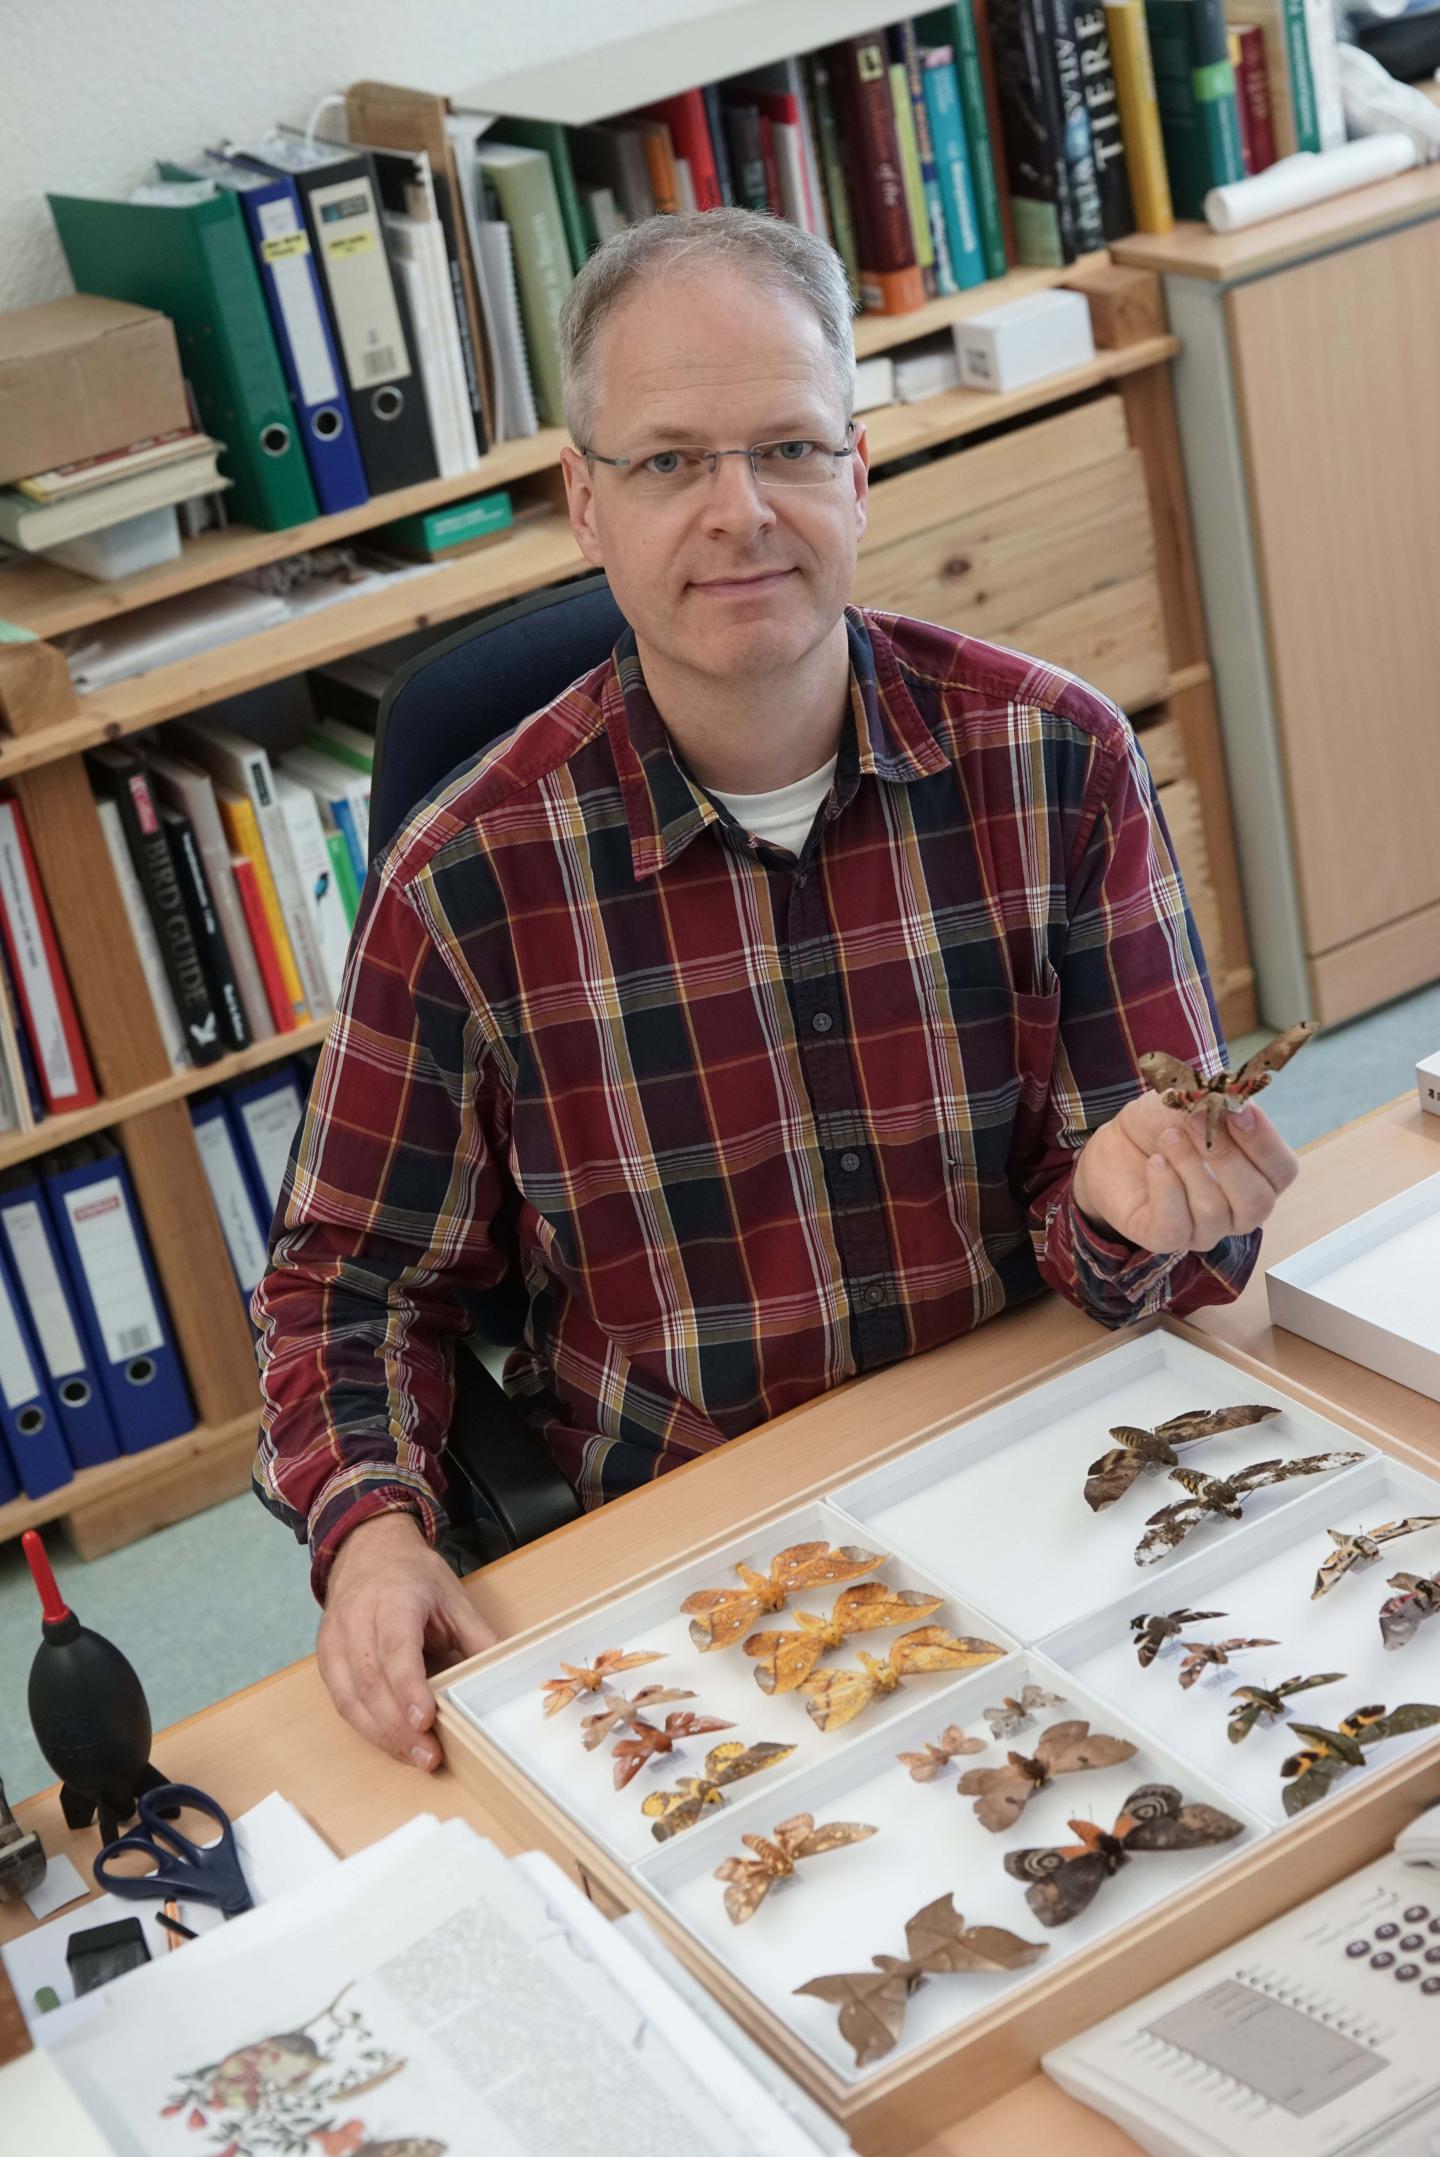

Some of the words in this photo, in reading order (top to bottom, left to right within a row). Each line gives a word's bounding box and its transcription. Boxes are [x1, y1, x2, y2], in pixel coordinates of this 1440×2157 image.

[1074, 8, 1123, 172] TIERE
[148, 839, 182, 911] BIRD
[166, 915, 208, 1006] GUIDE
